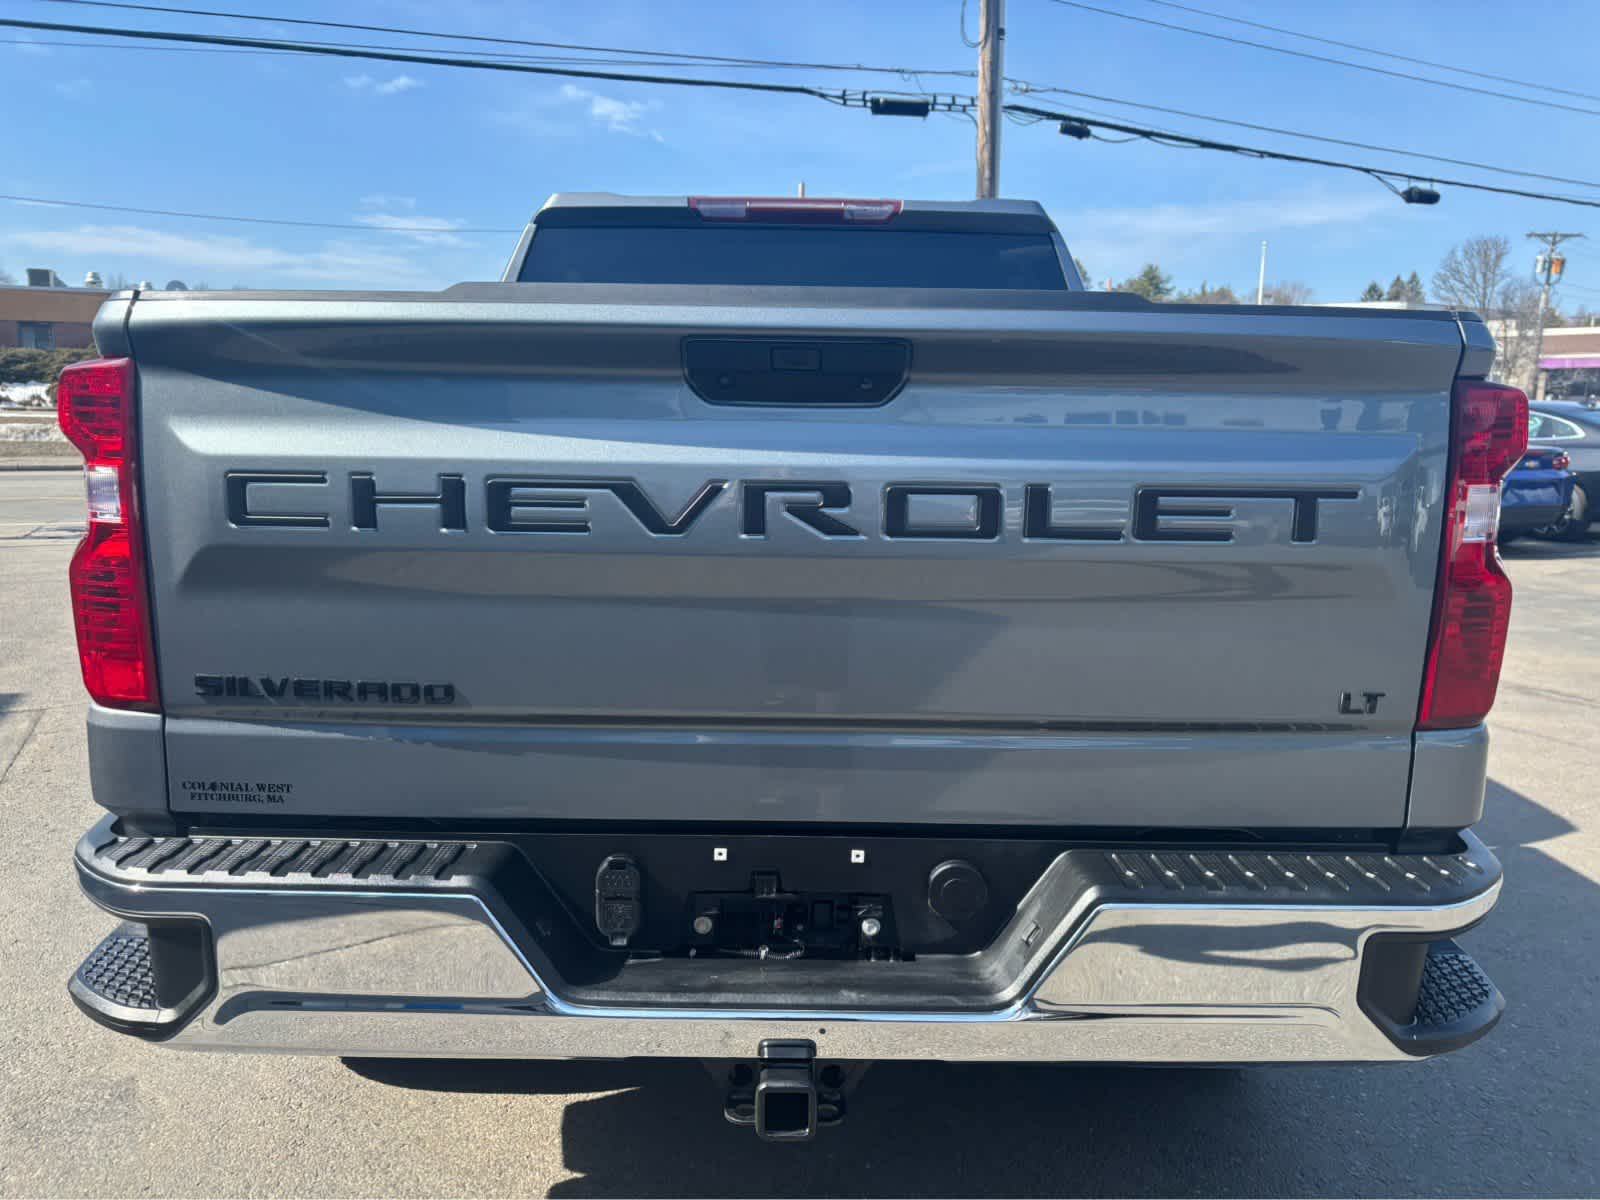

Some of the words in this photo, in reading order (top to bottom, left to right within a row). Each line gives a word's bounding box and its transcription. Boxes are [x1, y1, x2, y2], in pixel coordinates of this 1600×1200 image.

[224, 470, 1363, 545] CHEVROLET
[194, 672, 456, 704] SILVERADO
[1339, 691, 1386, 714] LT
[181, 780, 252, 792] COLONIAL
[255, 783, 293, 794] WEST
[266, 794, 285, 804] MA
